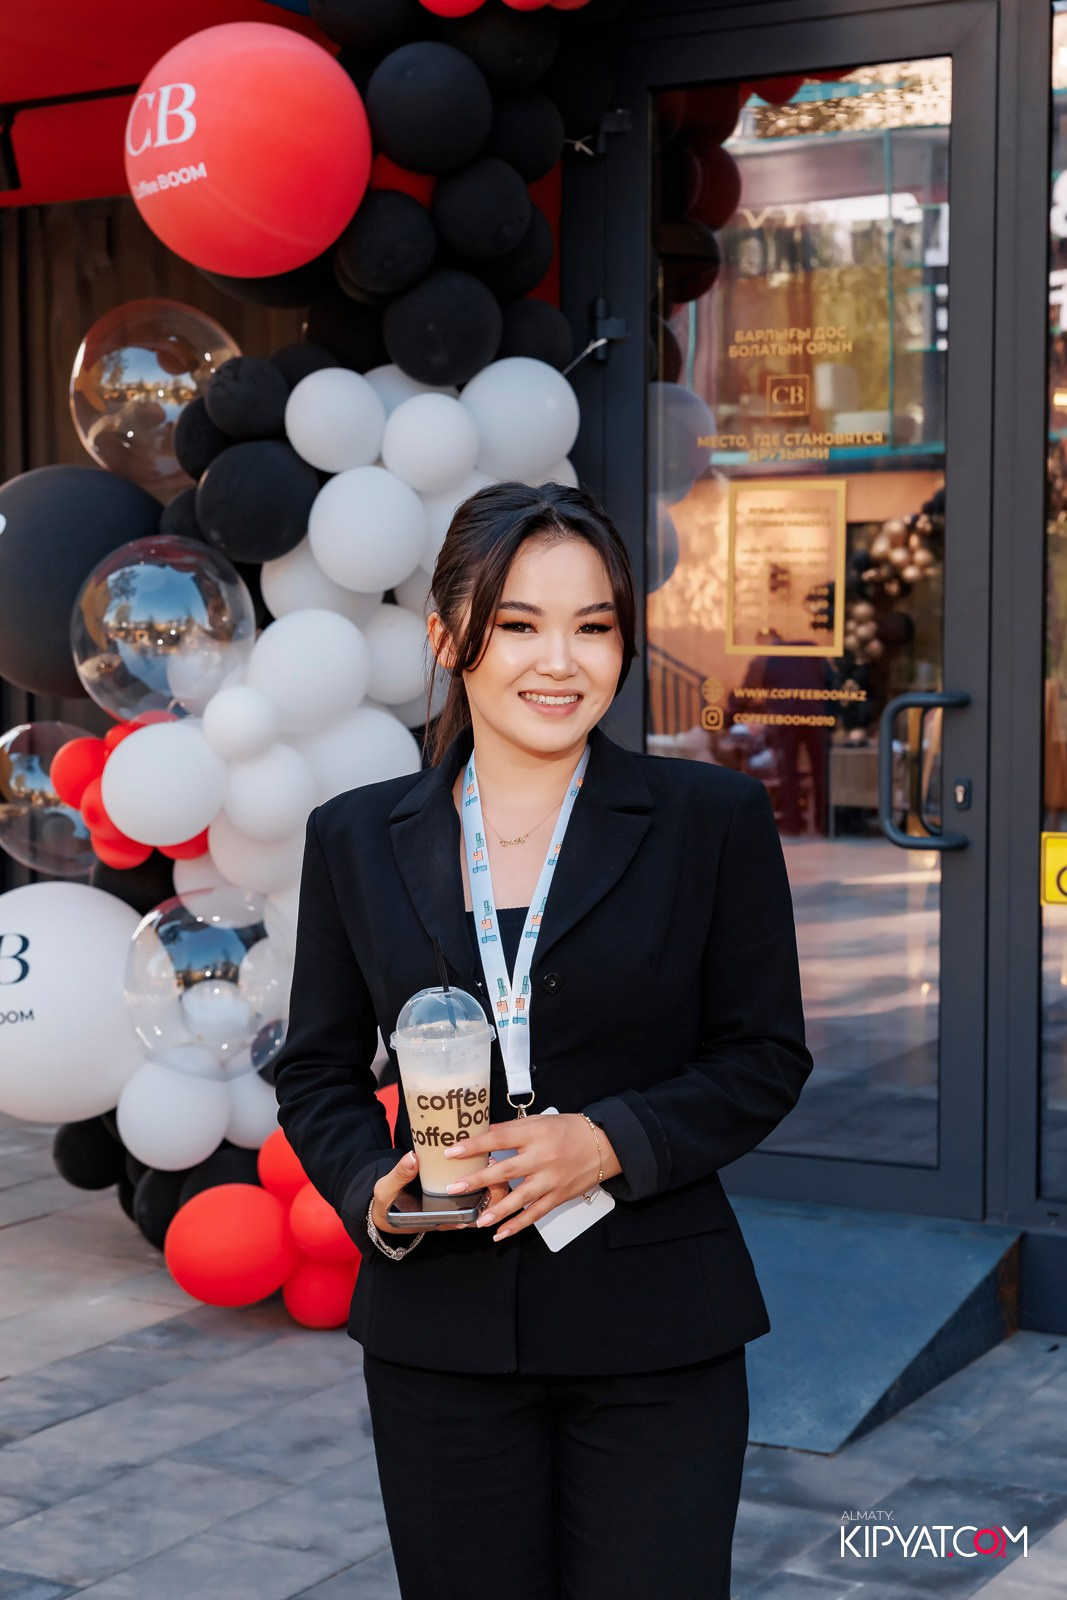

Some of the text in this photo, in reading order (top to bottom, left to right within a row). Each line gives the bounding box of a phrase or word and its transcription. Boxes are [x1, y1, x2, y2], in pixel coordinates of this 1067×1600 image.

[125, 82, 197, 157] CB
[814, 326, 847, 341] ДОС
[728, 341, 853, 358] БОЛАТЫН ОРЫН
[772, 385, 804, 405] CB
[753, 434, 780, 446] ГДЕ
[783, 431, 883, 446] СТАНОВЯТСЯ
[733, 688, 867, 702] WWW.COFFEEBOOM.KZ
[417, 1087, 487, 1111] coffee
